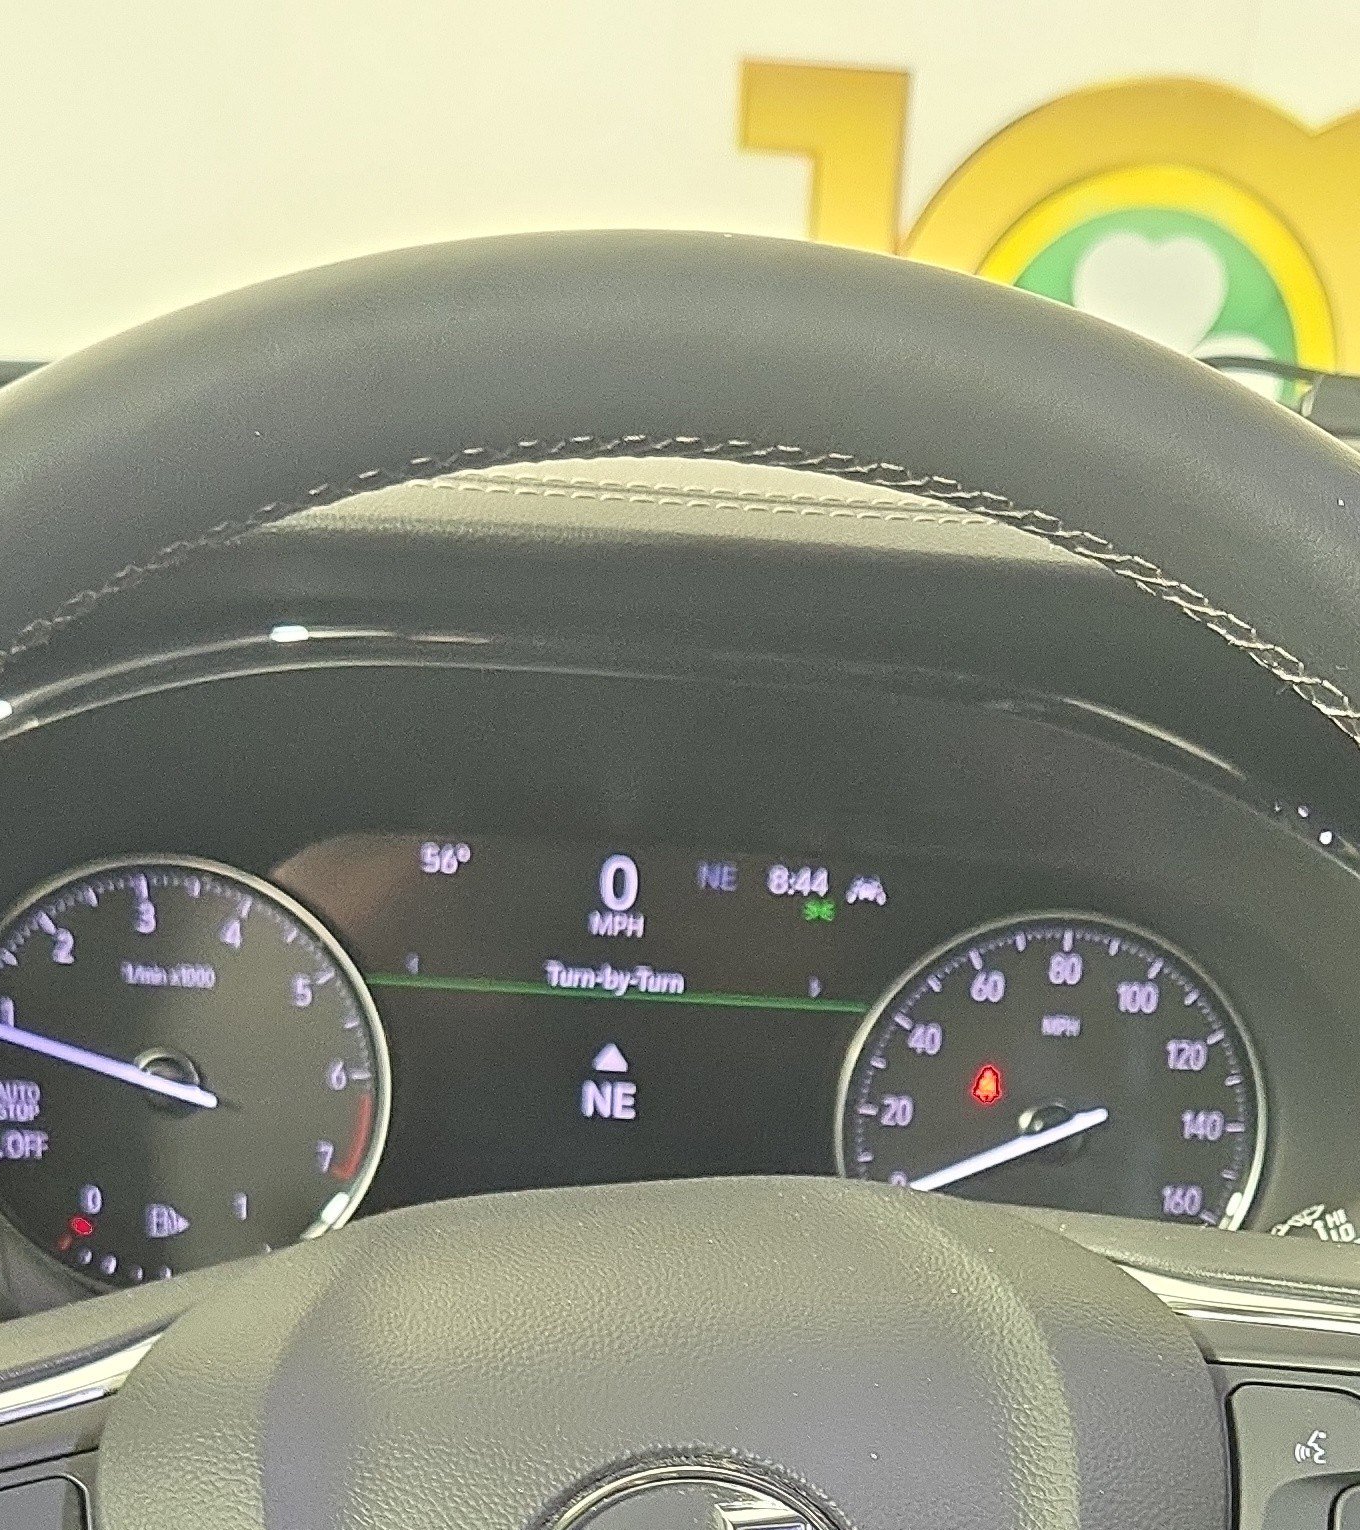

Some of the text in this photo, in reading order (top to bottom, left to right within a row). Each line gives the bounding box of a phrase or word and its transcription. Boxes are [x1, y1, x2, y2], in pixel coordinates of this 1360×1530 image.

[599, 854, 638, 911] 0
[697, 862, 737, 892] NE
[767, 865, 829, 898] 8:44
[134, 903, 157, 935] 3
[220, 920, 242, 948] 4
[588, 911, 644, 937] MPH
[51, 929, 76, 964] 2
[545, 959, 685, 994] Turn-by-Turn
[1049, 953, 1083, 985] 80
[292, 975, 315, 1007] 5
[970, 970, 1006, 1003] 60
[1117, 981, 1160, 1014] 100
[907, 1023, 943, 1055] 40
[1167, 1040, 1208, 1072] 120
[327, 1061, 347, 1090] 6
[581, 1081, 637, 1121] NE
[880, 1096, 914, 1127] 20
[1182, 1111, 1224, 1141] 140
[3, 1130, 49, 1159] OFF
[314, 1140, 334, 1173] 7
[1162, 1184, 1202, 1217] 160
